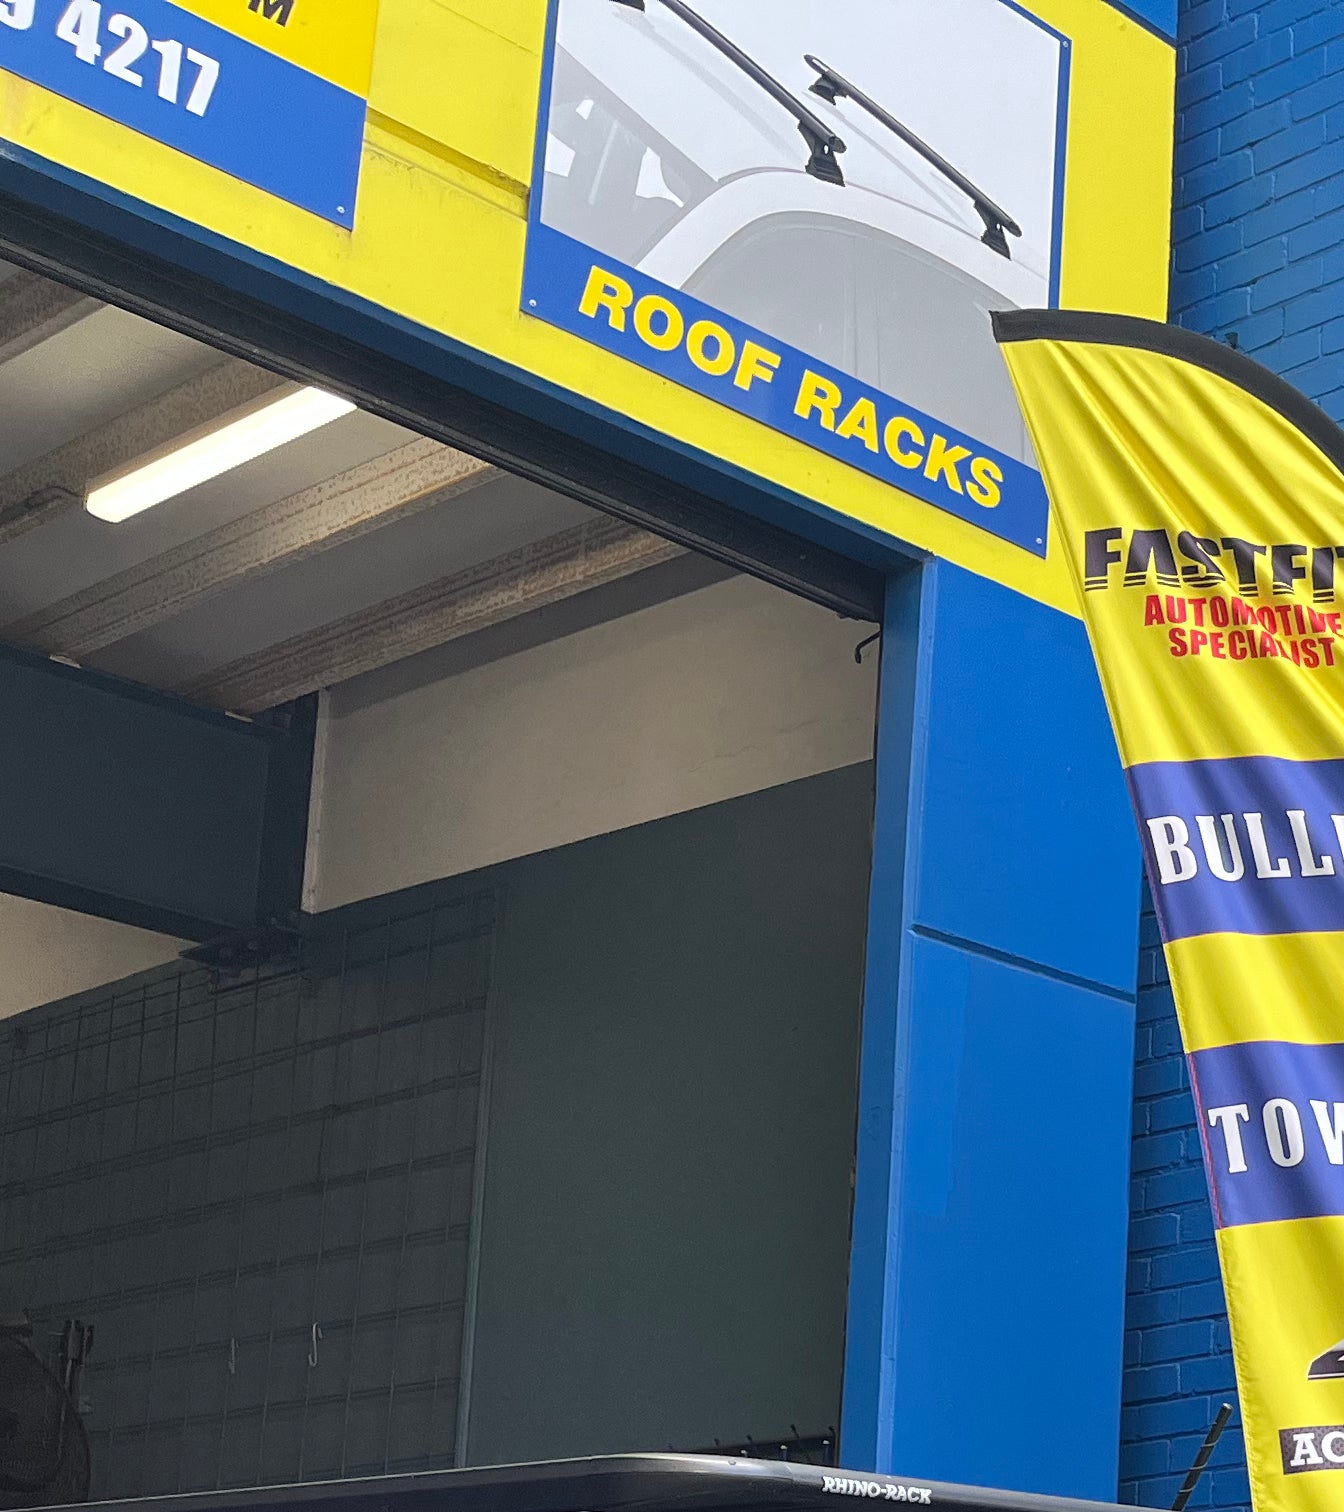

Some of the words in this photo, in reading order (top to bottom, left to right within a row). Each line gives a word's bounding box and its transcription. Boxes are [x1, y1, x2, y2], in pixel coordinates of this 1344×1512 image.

[56, 0, 220, 117] 4217
[578, 265, 781, 391] ROOF
[793, 369, 1004, 509] RACKS
[1144, 594, 1344, 639] AUTOMOTIVE
[1168, 627, 1335, 669] SPECIALIST
[821, 1476, 933, 1505] RHINO-RACK
